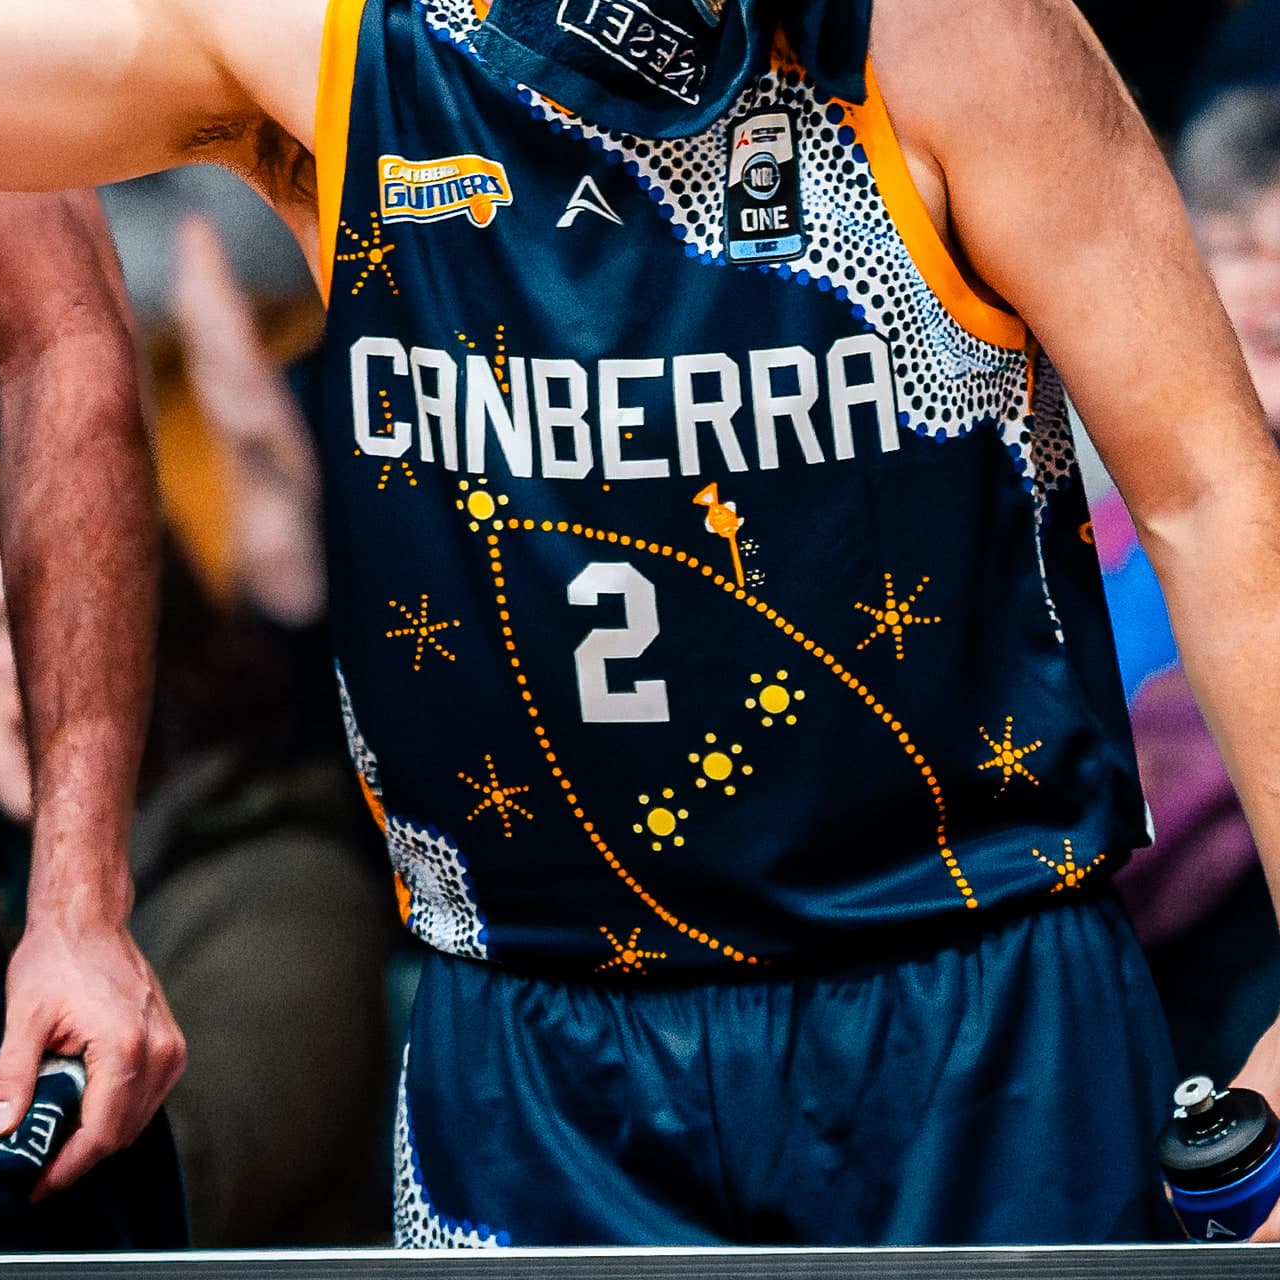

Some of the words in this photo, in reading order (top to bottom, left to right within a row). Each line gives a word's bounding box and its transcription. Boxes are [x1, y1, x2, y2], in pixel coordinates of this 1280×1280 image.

[384, 173, 504, 209] GUNNERS
[740, 205, 790, 232] ONE
[348, 332, 901, 481] CANBERRA
[566, 562, 670, 723] 2
